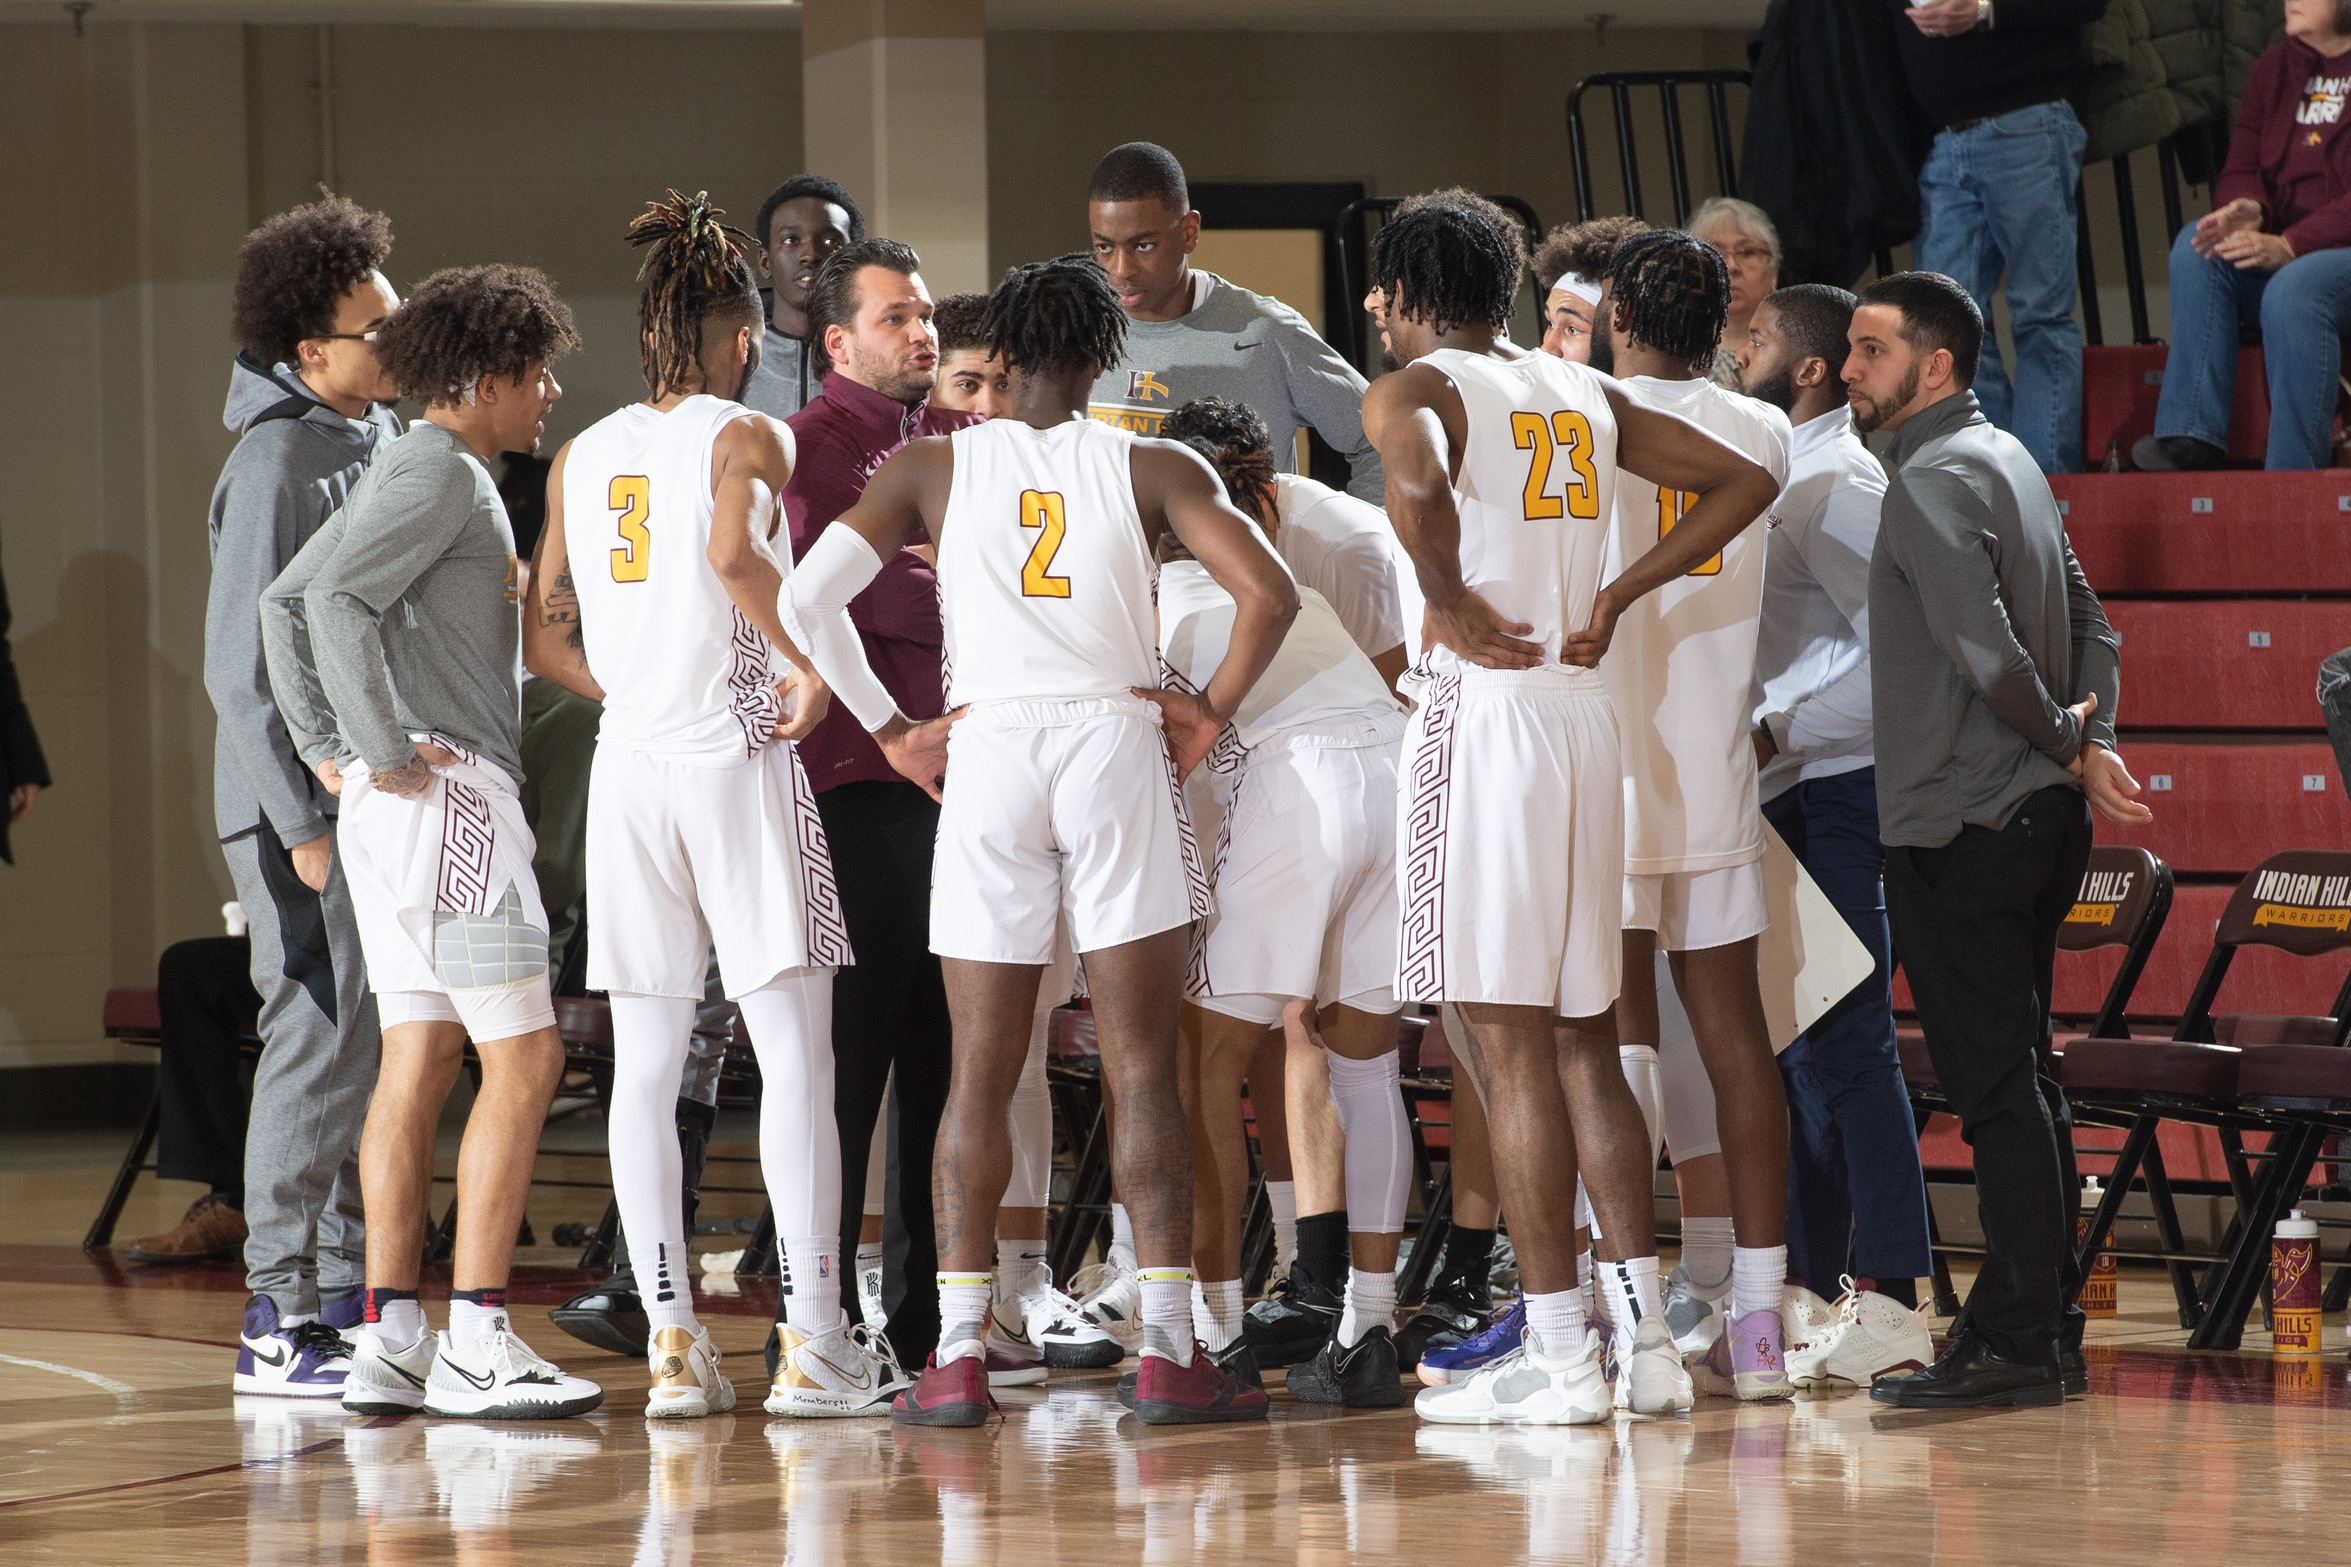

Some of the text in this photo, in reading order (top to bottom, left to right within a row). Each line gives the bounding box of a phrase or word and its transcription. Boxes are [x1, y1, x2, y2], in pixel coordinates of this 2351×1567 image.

[1510, 410, 1599, 521] 23
[608, 475, 650, 583] 3
[1020, 489, 1071, 598] 2
[2311, 777, 2317, 788] 7
[2086, 872, 2134, 901] HILLS
[2252, 870, 2351, 907] INDIAN HIL
[2266, 909, 2345, 923] WARRIORS
[2276, 1317, 2312, 1334] HILLS
